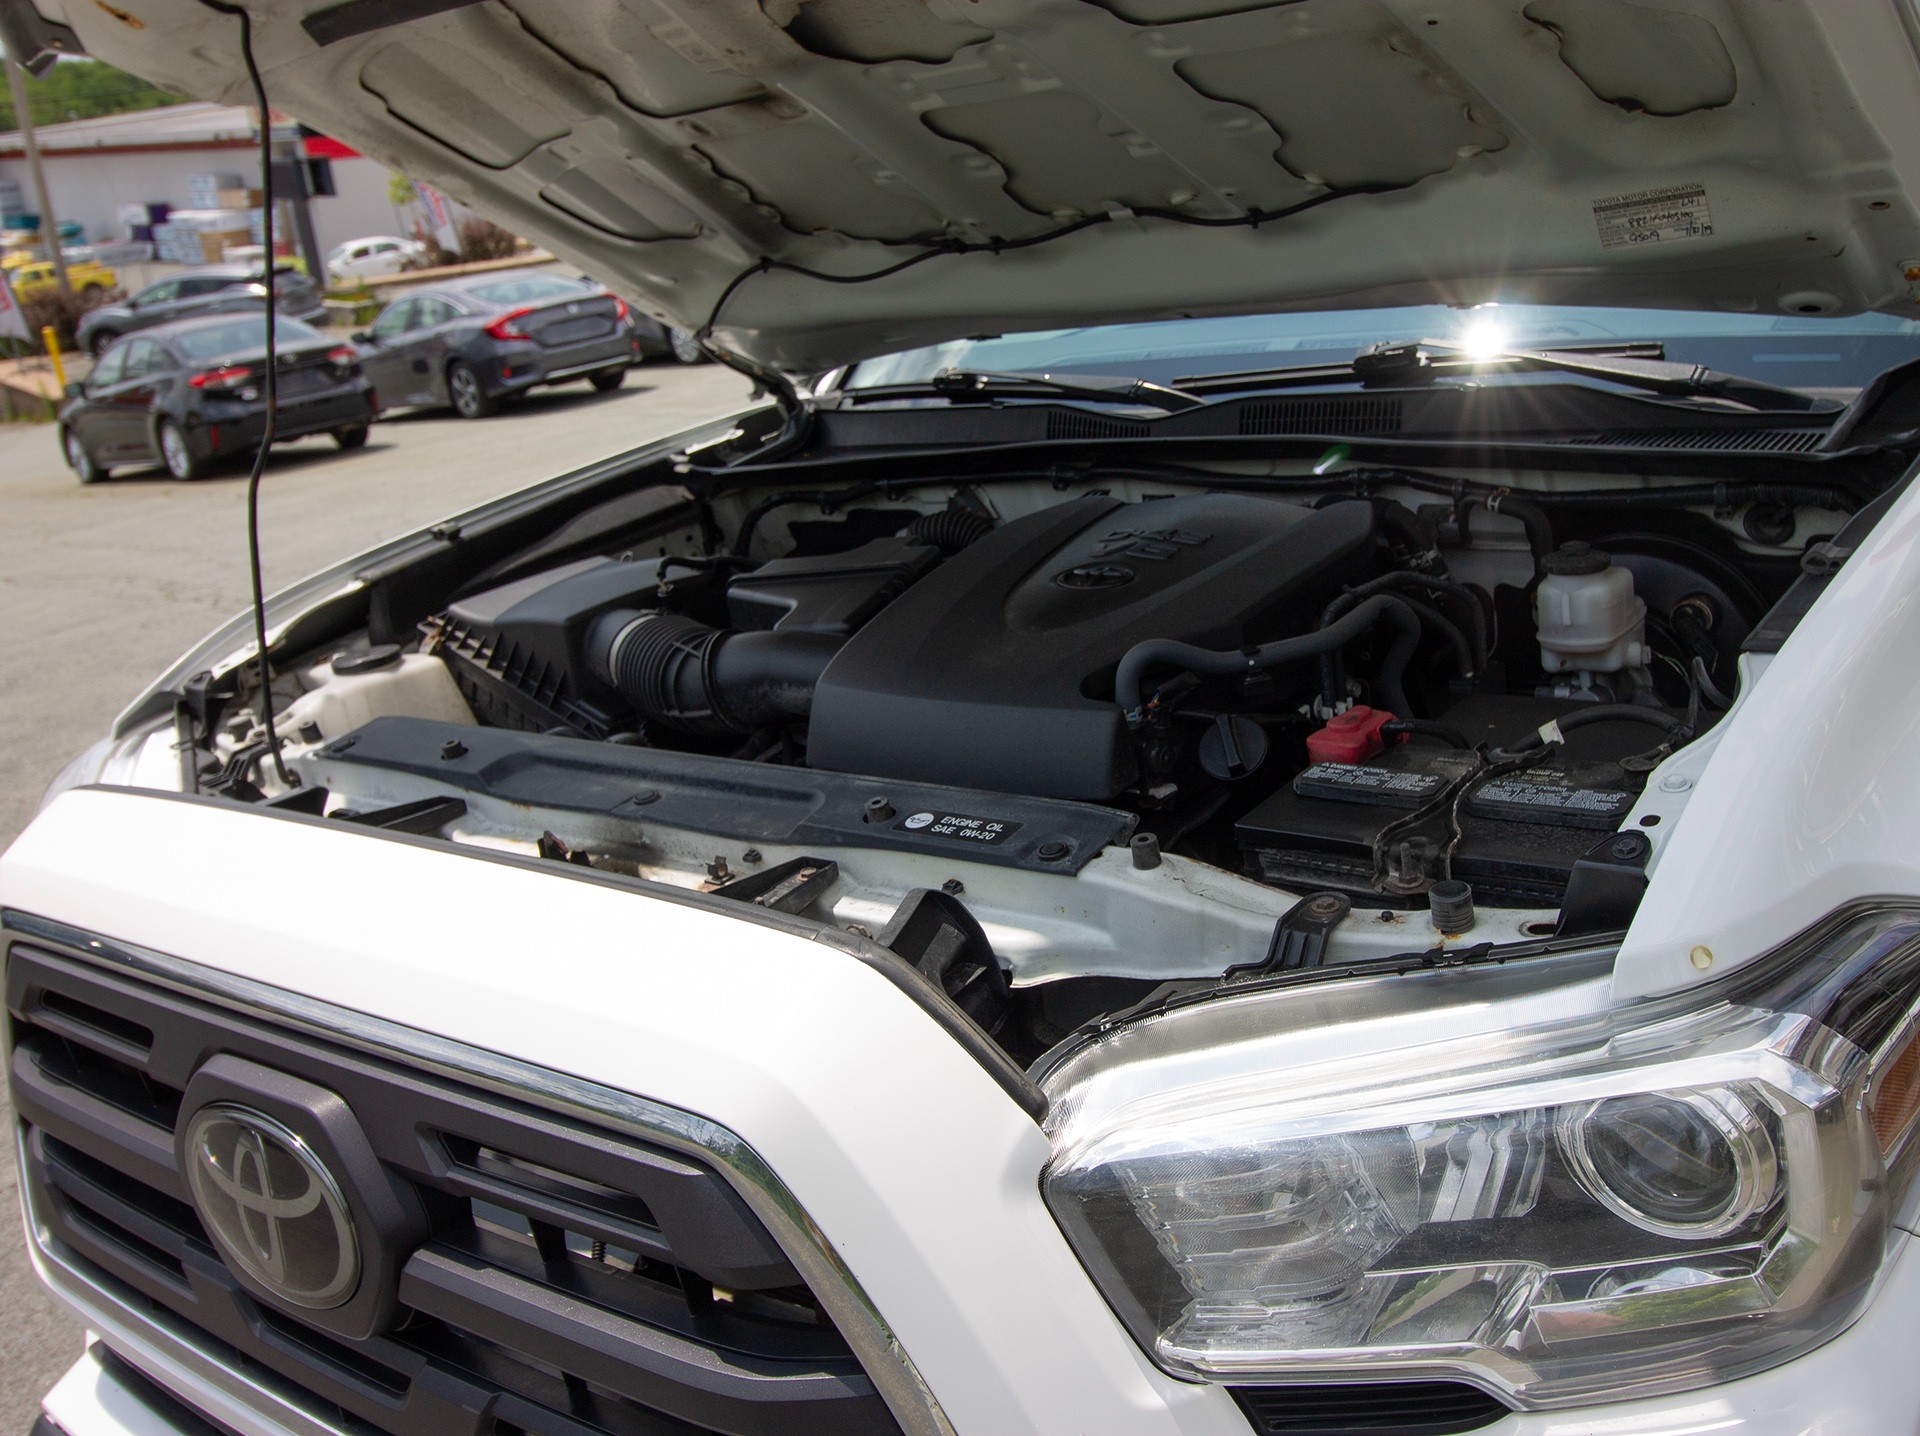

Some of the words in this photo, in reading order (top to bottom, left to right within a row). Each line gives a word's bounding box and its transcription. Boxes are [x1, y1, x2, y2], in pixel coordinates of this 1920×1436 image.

[1592, 197, 1622, 207] TOYOTA
[1622, 191, 1649, 202] MOTOR
[1649, 184, 1703, 198] CORPORATION
[940, 816, 983, 828] ENGINE
[986, 823, 1003, 832] OIL
[931, 825, 956, 834] SAE
[960, 829, 996, 840] 0W-20
